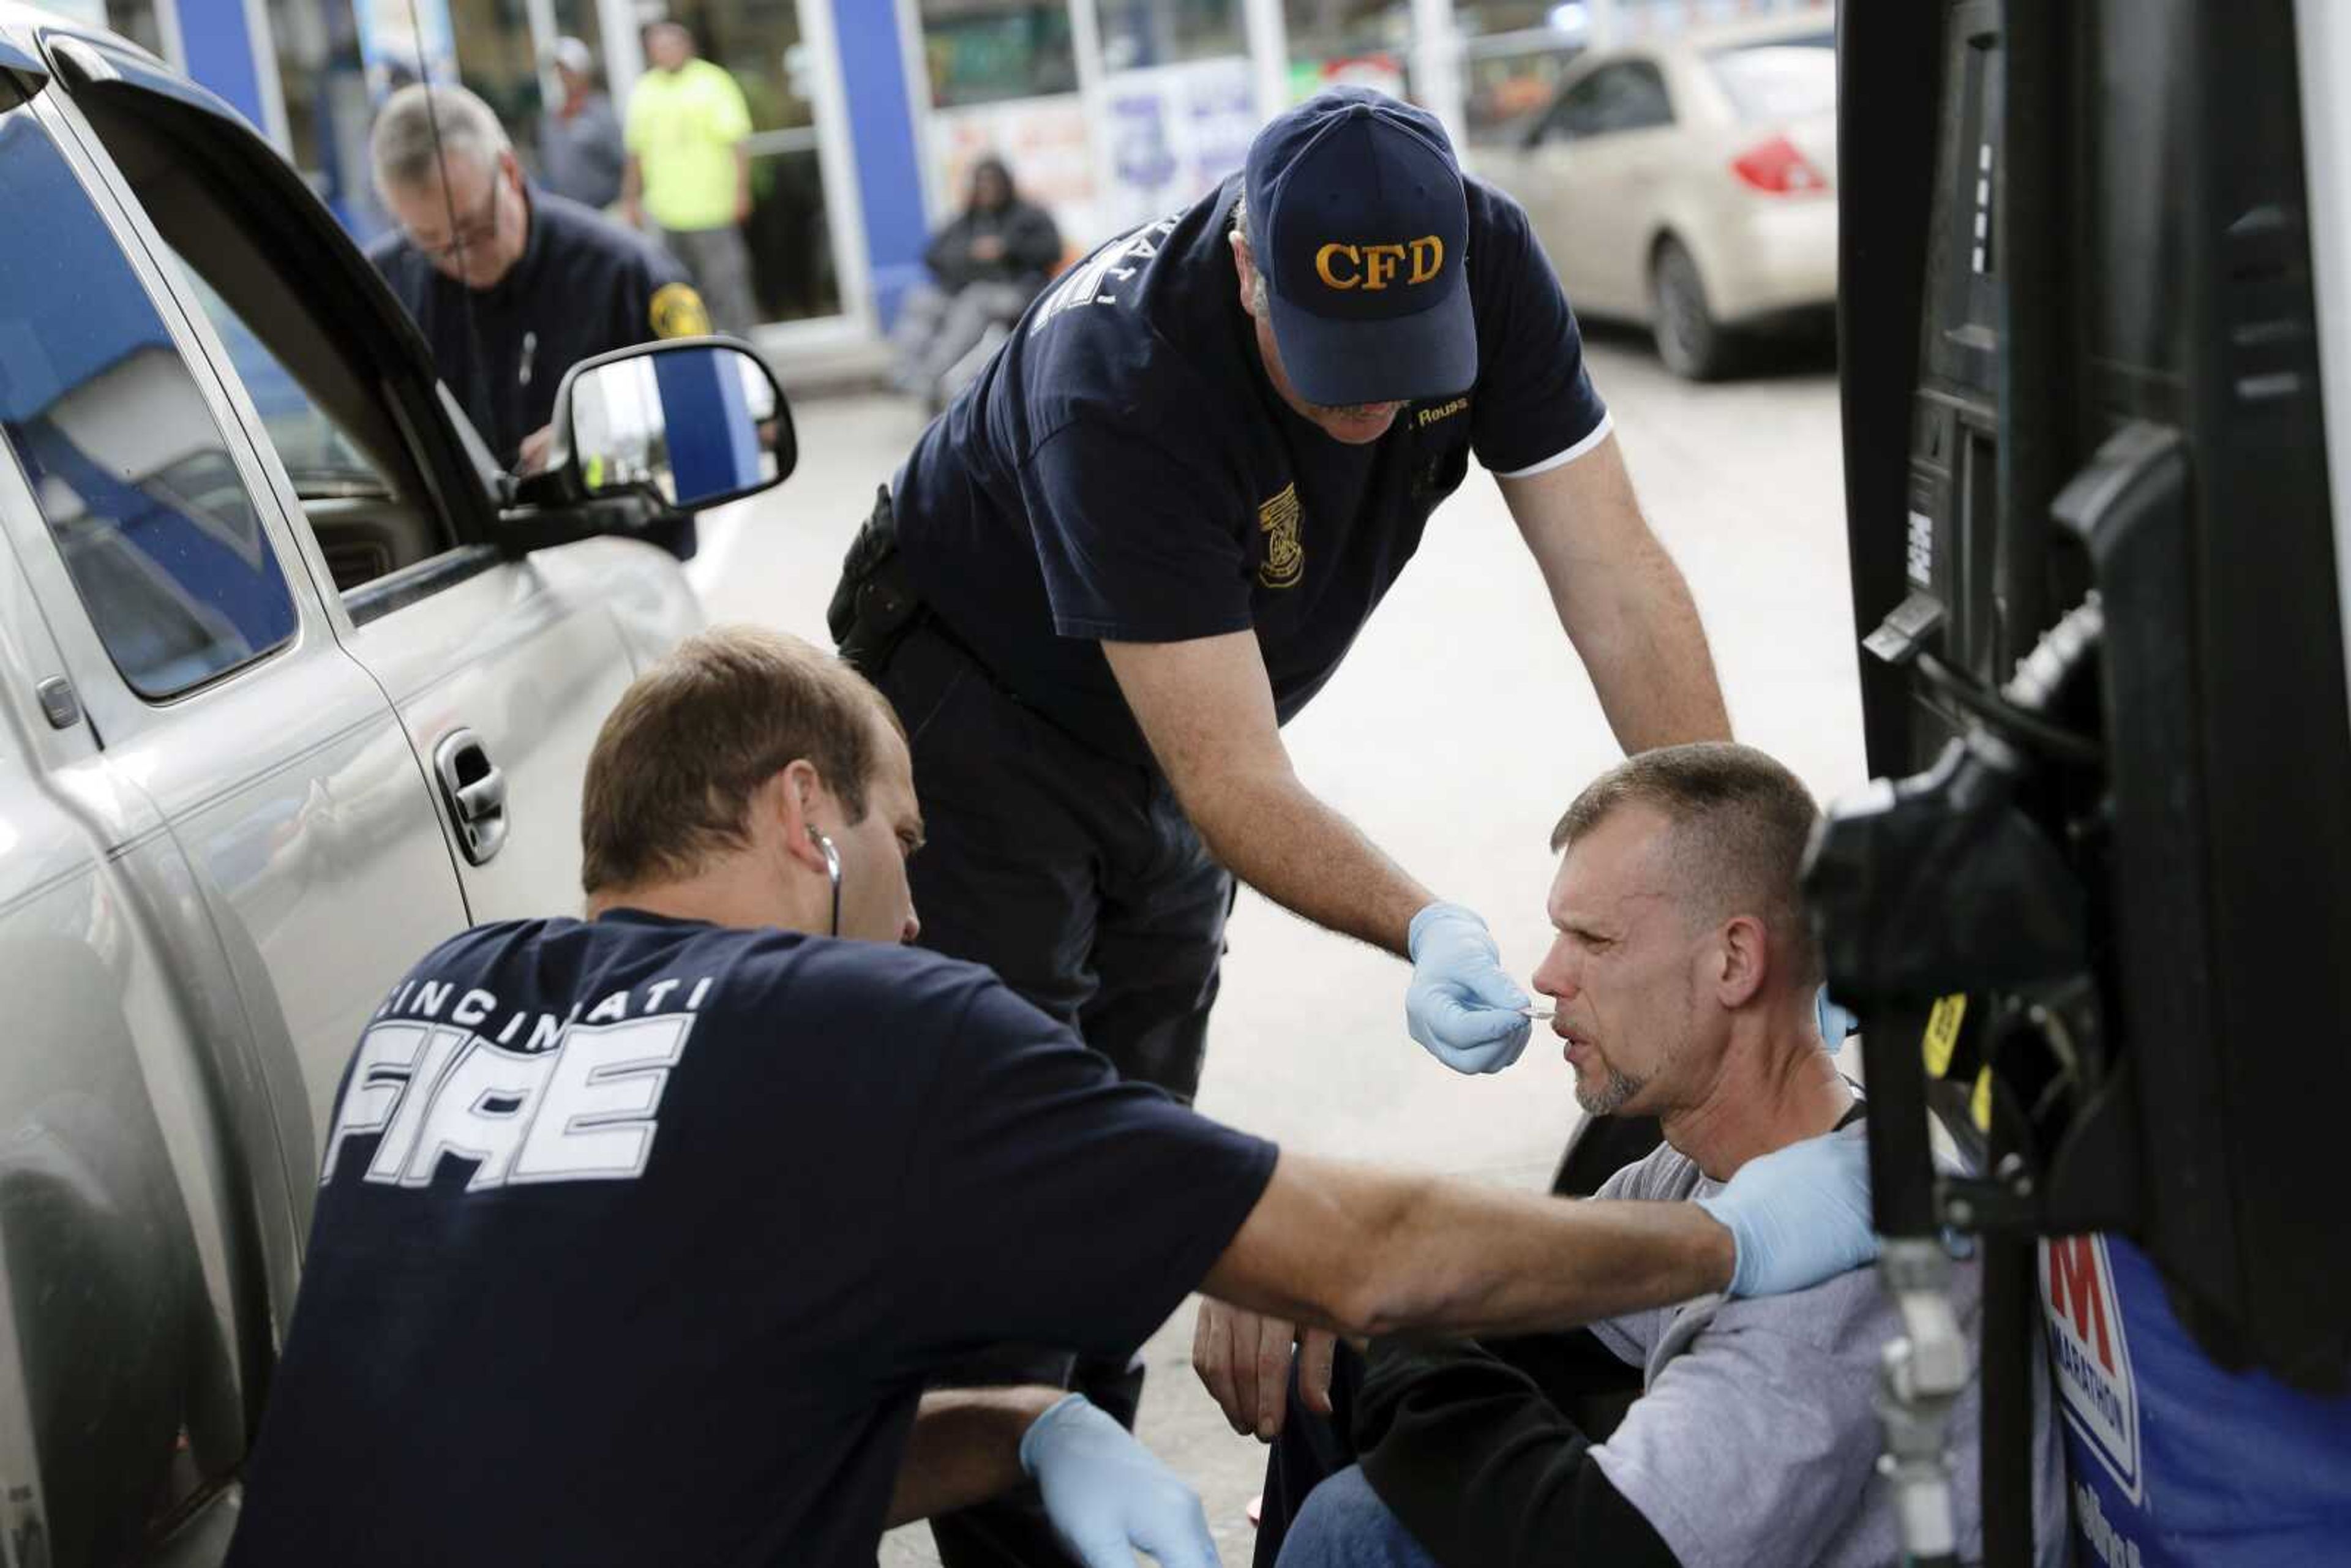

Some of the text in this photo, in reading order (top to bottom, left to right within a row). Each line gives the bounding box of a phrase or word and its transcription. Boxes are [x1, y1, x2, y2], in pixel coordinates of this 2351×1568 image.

[1316, 234, 1444, 290] CFD
[319, 1012, 697, 1191] FIRE
[2051, 1319, 2126, 1444] MARATHON
